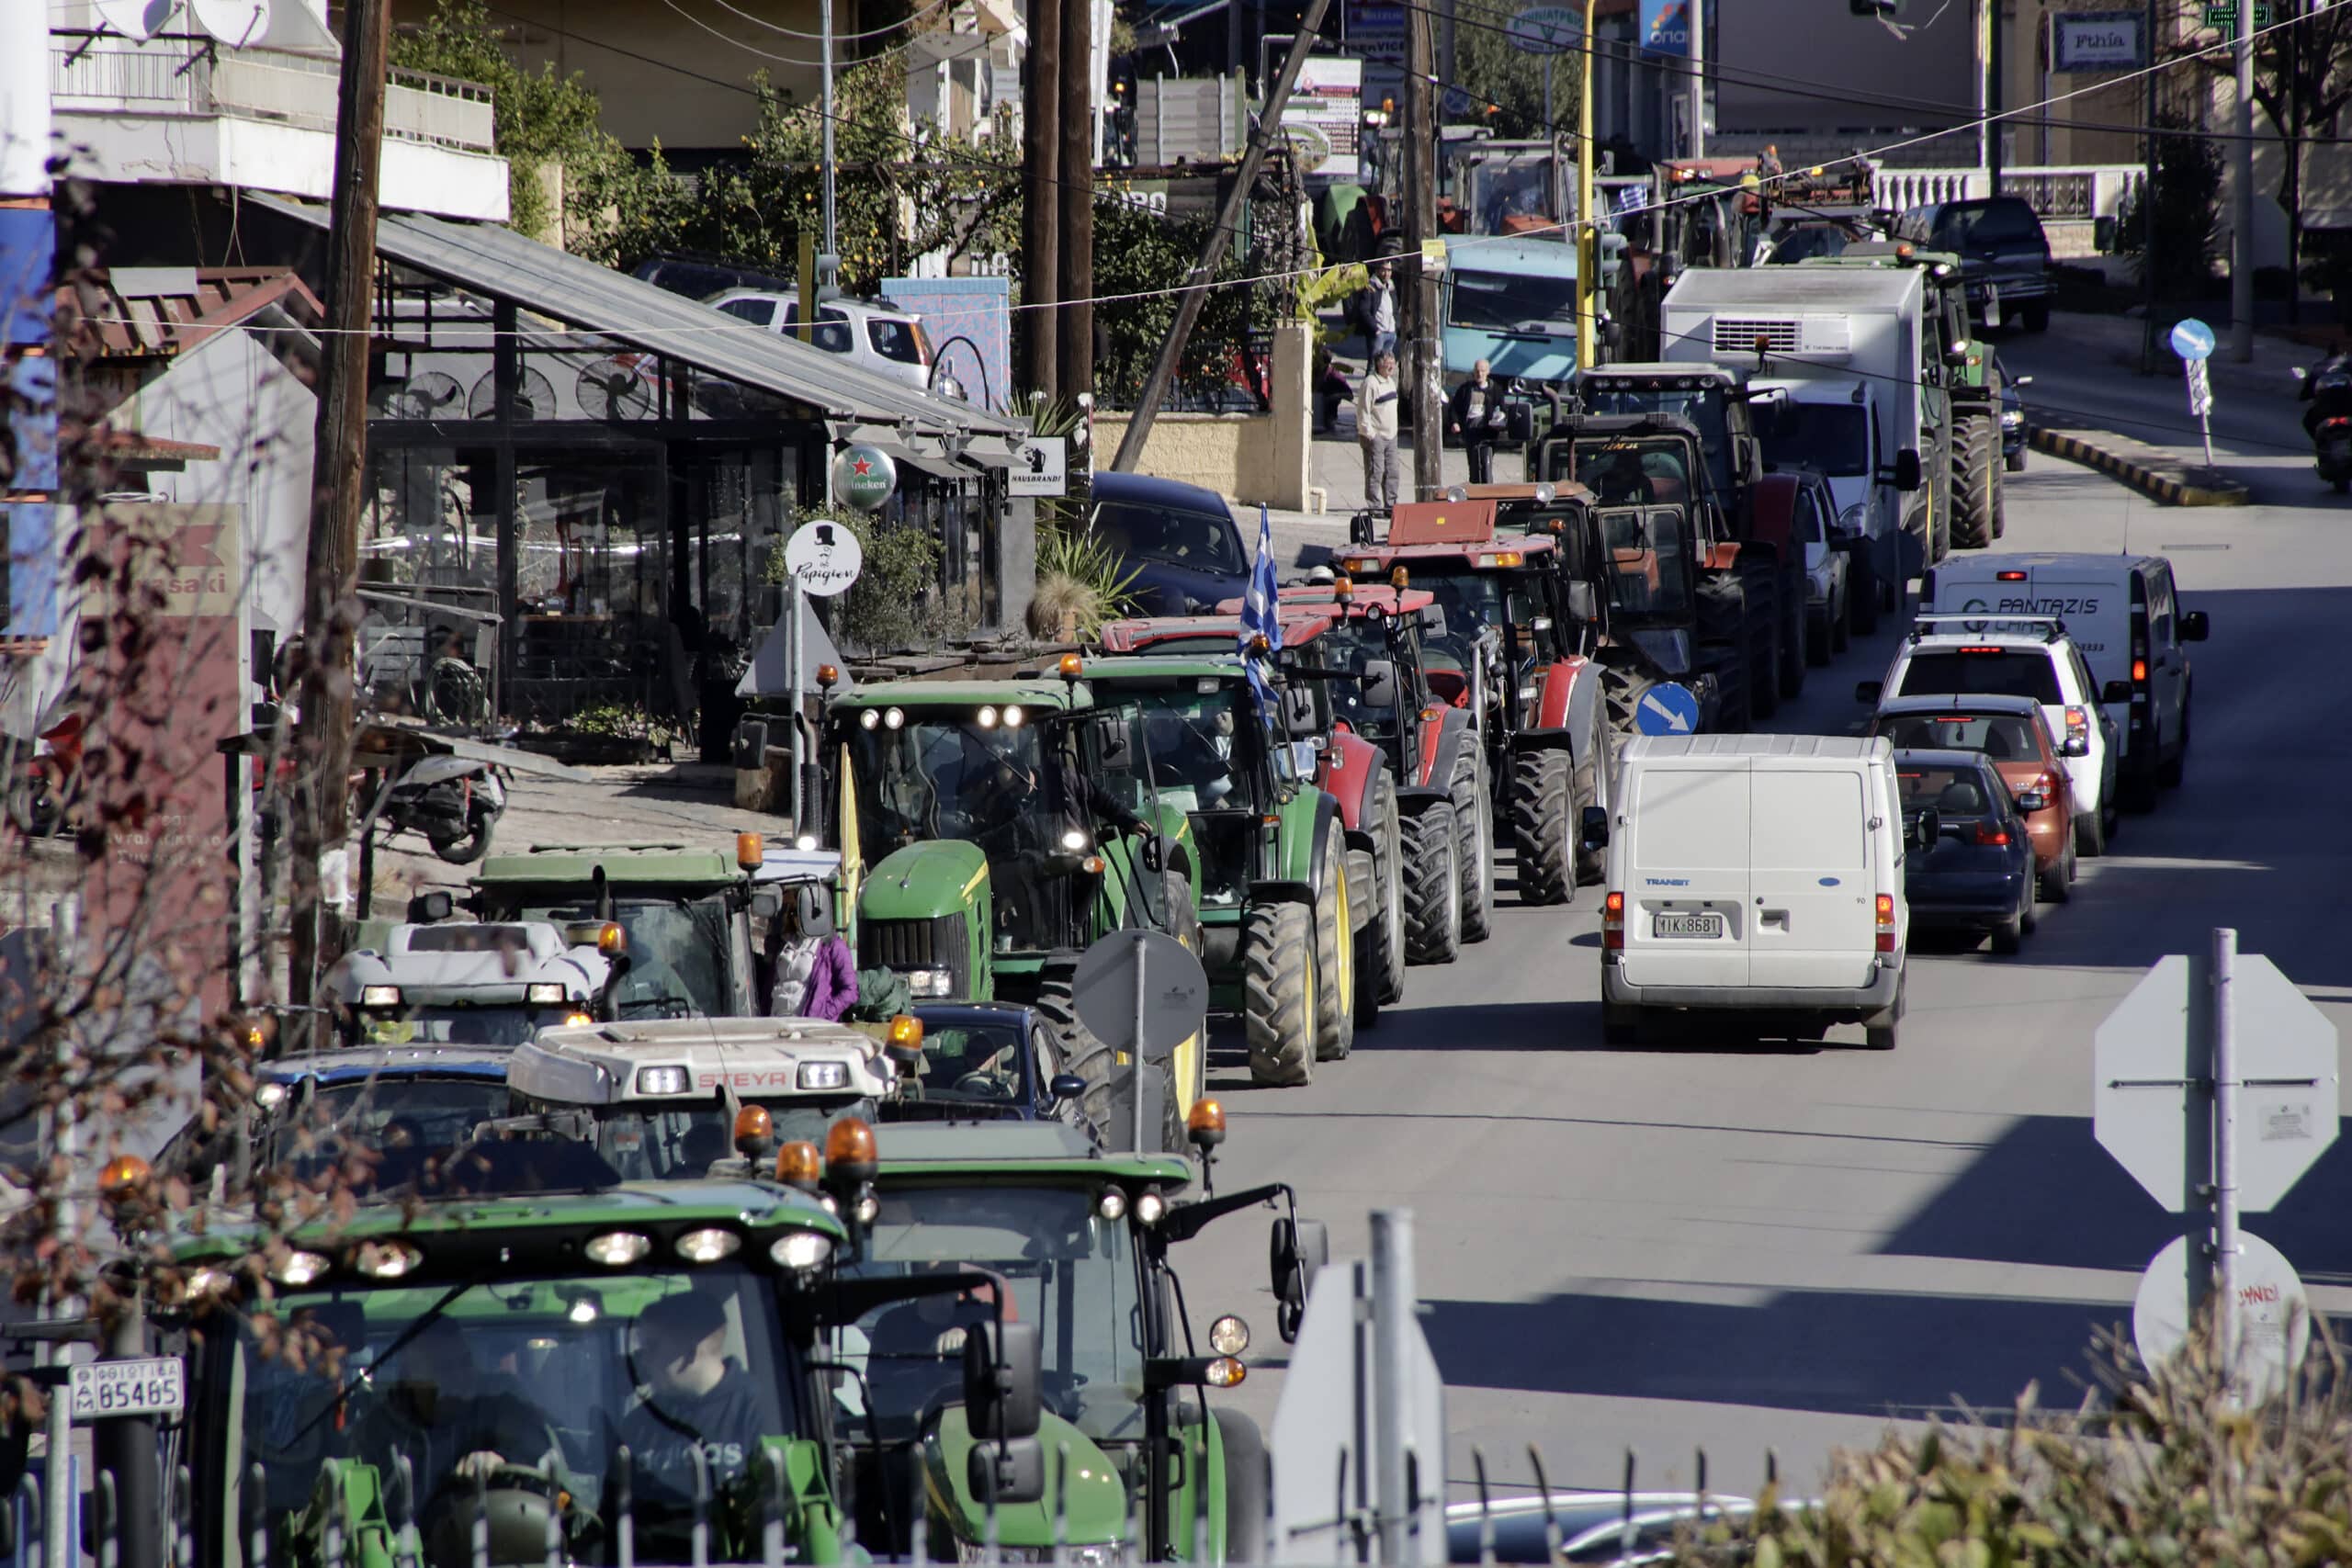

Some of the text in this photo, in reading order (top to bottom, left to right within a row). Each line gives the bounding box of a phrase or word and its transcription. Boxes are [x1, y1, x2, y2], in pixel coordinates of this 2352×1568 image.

[1997, 598, 2099, 615] PANTAZIS
[1645, 878, 1690, 886] TRANSIT
[698, 1072, 787, 1088] STEYR
